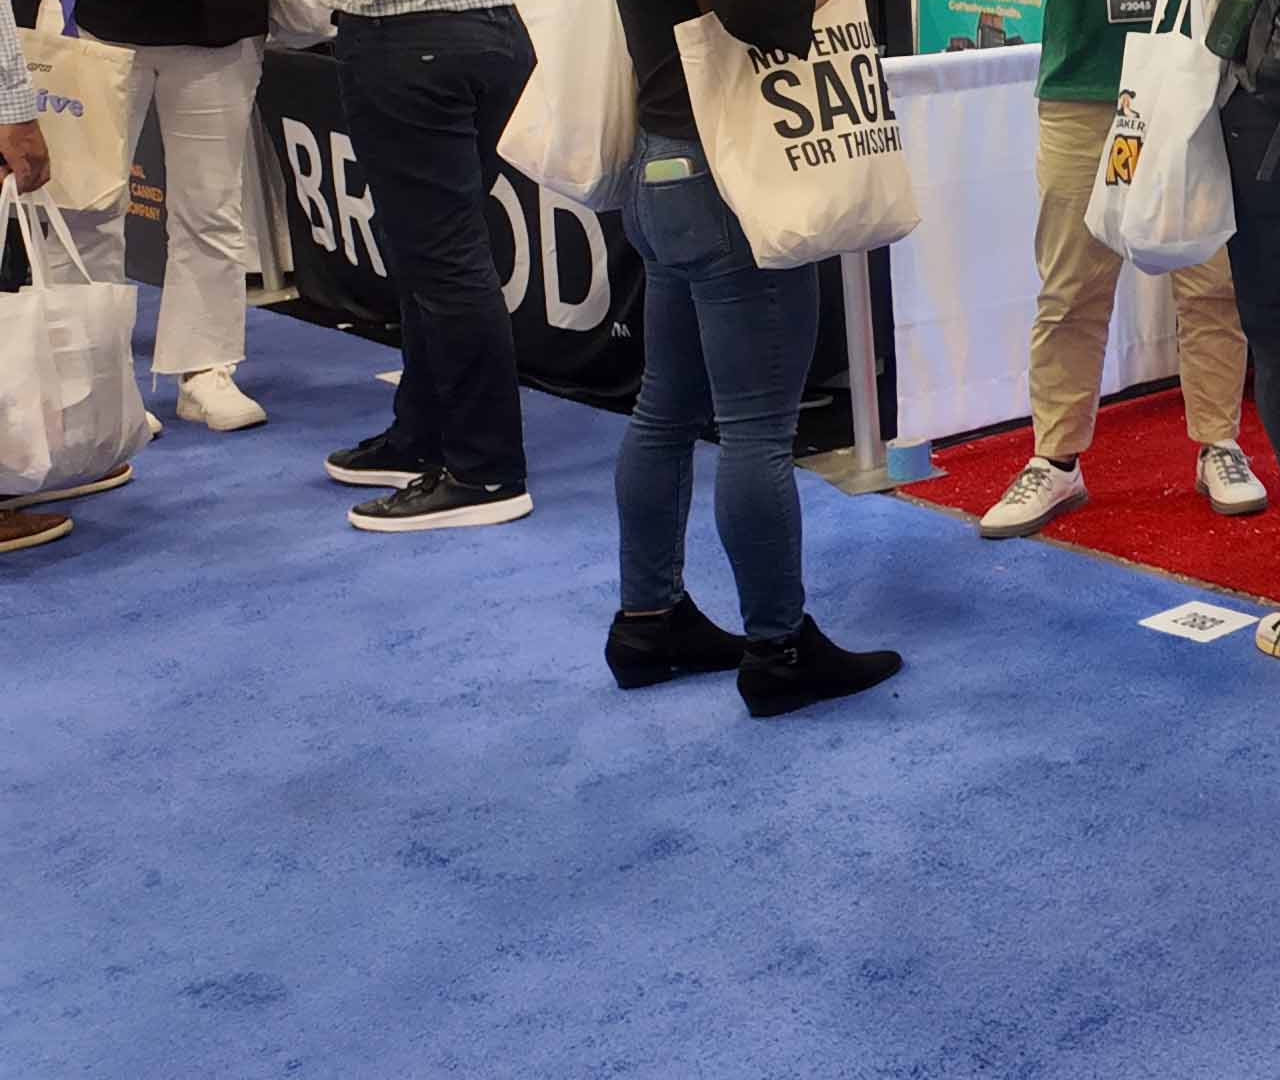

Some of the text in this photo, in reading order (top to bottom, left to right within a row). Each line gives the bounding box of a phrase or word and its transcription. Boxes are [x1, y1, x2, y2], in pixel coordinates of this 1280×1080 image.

[813, 21, 880, 56] ENOU
[36, 88, 84, 118] ive
[1116, 118, 1146, 132] AKER
[785, 138, 837, 172] FOR
